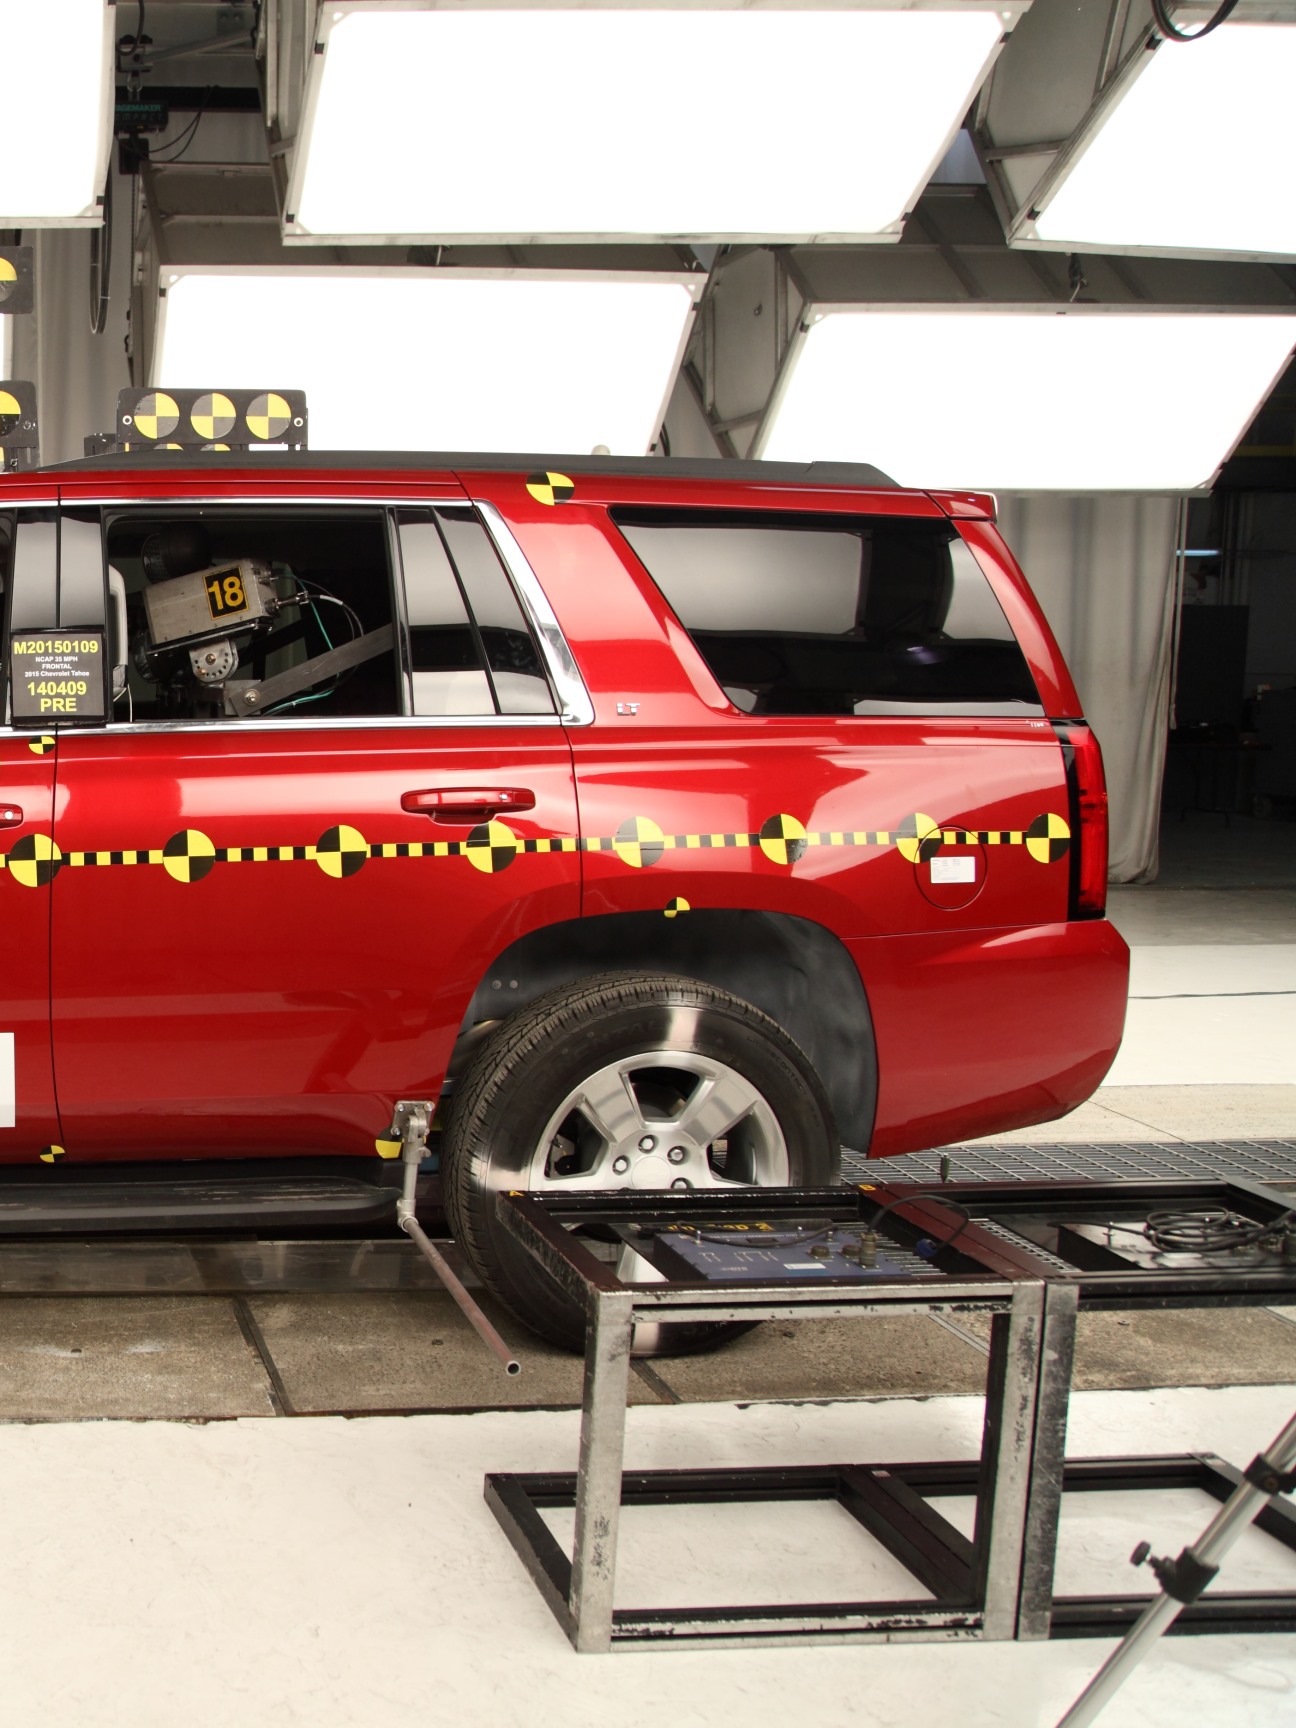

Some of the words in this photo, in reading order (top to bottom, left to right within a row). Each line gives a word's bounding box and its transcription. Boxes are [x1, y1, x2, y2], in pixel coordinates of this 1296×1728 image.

[207, 575, 245, 611] 18
[13, 639, 99, 655] M20150109
[27, 681, 87, 696] 140409
[40, 698, 77, 712] PRE
[615, 702, 641, 716] LT
